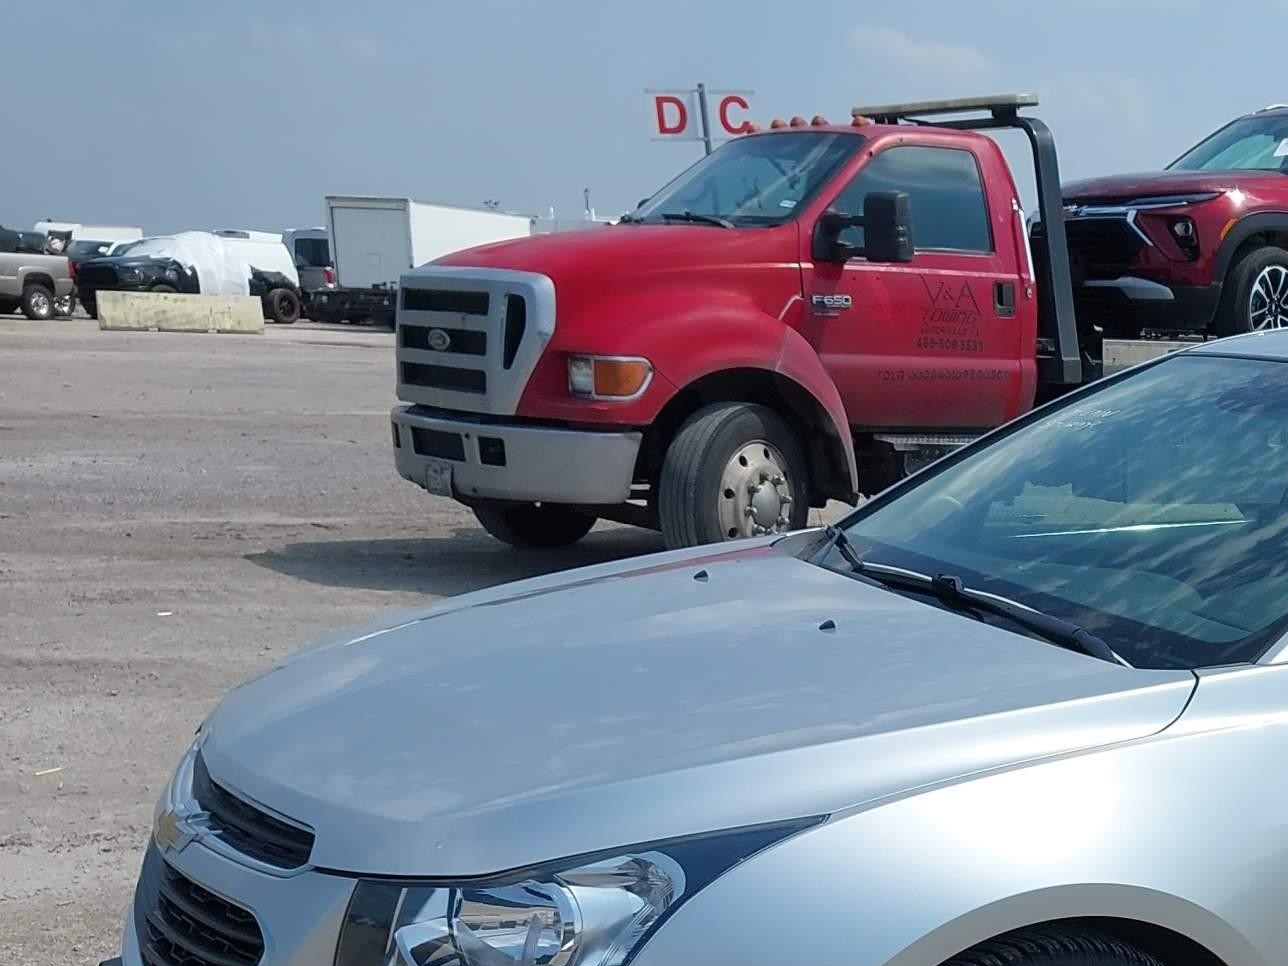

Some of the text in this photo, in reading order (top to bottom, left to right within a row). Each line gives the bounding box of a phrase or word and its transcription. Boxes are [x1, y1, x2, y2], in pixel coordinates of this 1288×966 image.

[655, 96, 751, 135] D C
[812, 294, 852, 306] F650
[919, 273, 982, 315] V&A
